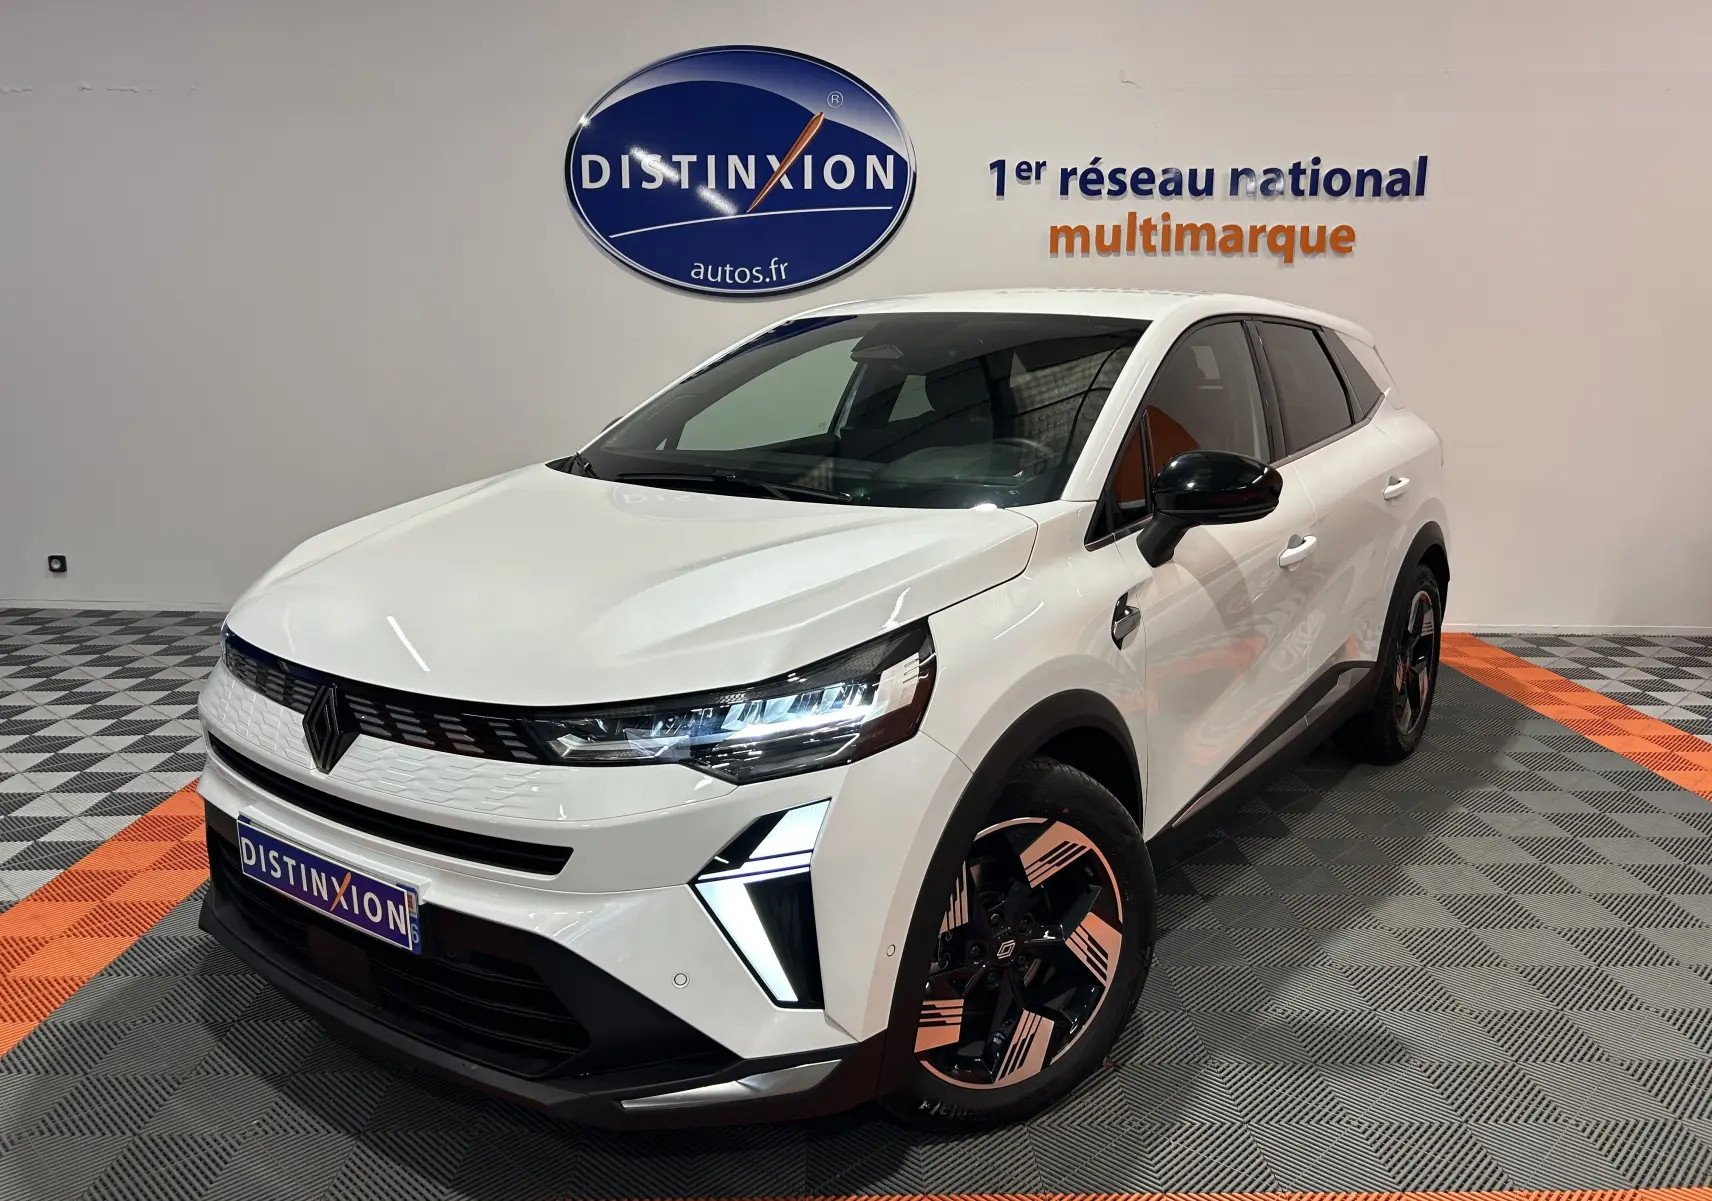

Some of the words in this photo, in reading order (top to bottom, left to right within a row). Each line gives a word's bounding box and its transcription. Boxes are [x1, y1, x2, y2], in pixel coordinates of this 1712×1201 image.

[581, 154, 895, 190] DISTINXION
[989, 159, 1047, 197] 1er
[1060, 157, 1214, 197] réseau
[1230, 155, 1428, 197] national
[1049, 211, 1356, 264] multimarque
[690, 257, 789, 284] autos.fr
[240, 836, 407, 936] DISTINXION
